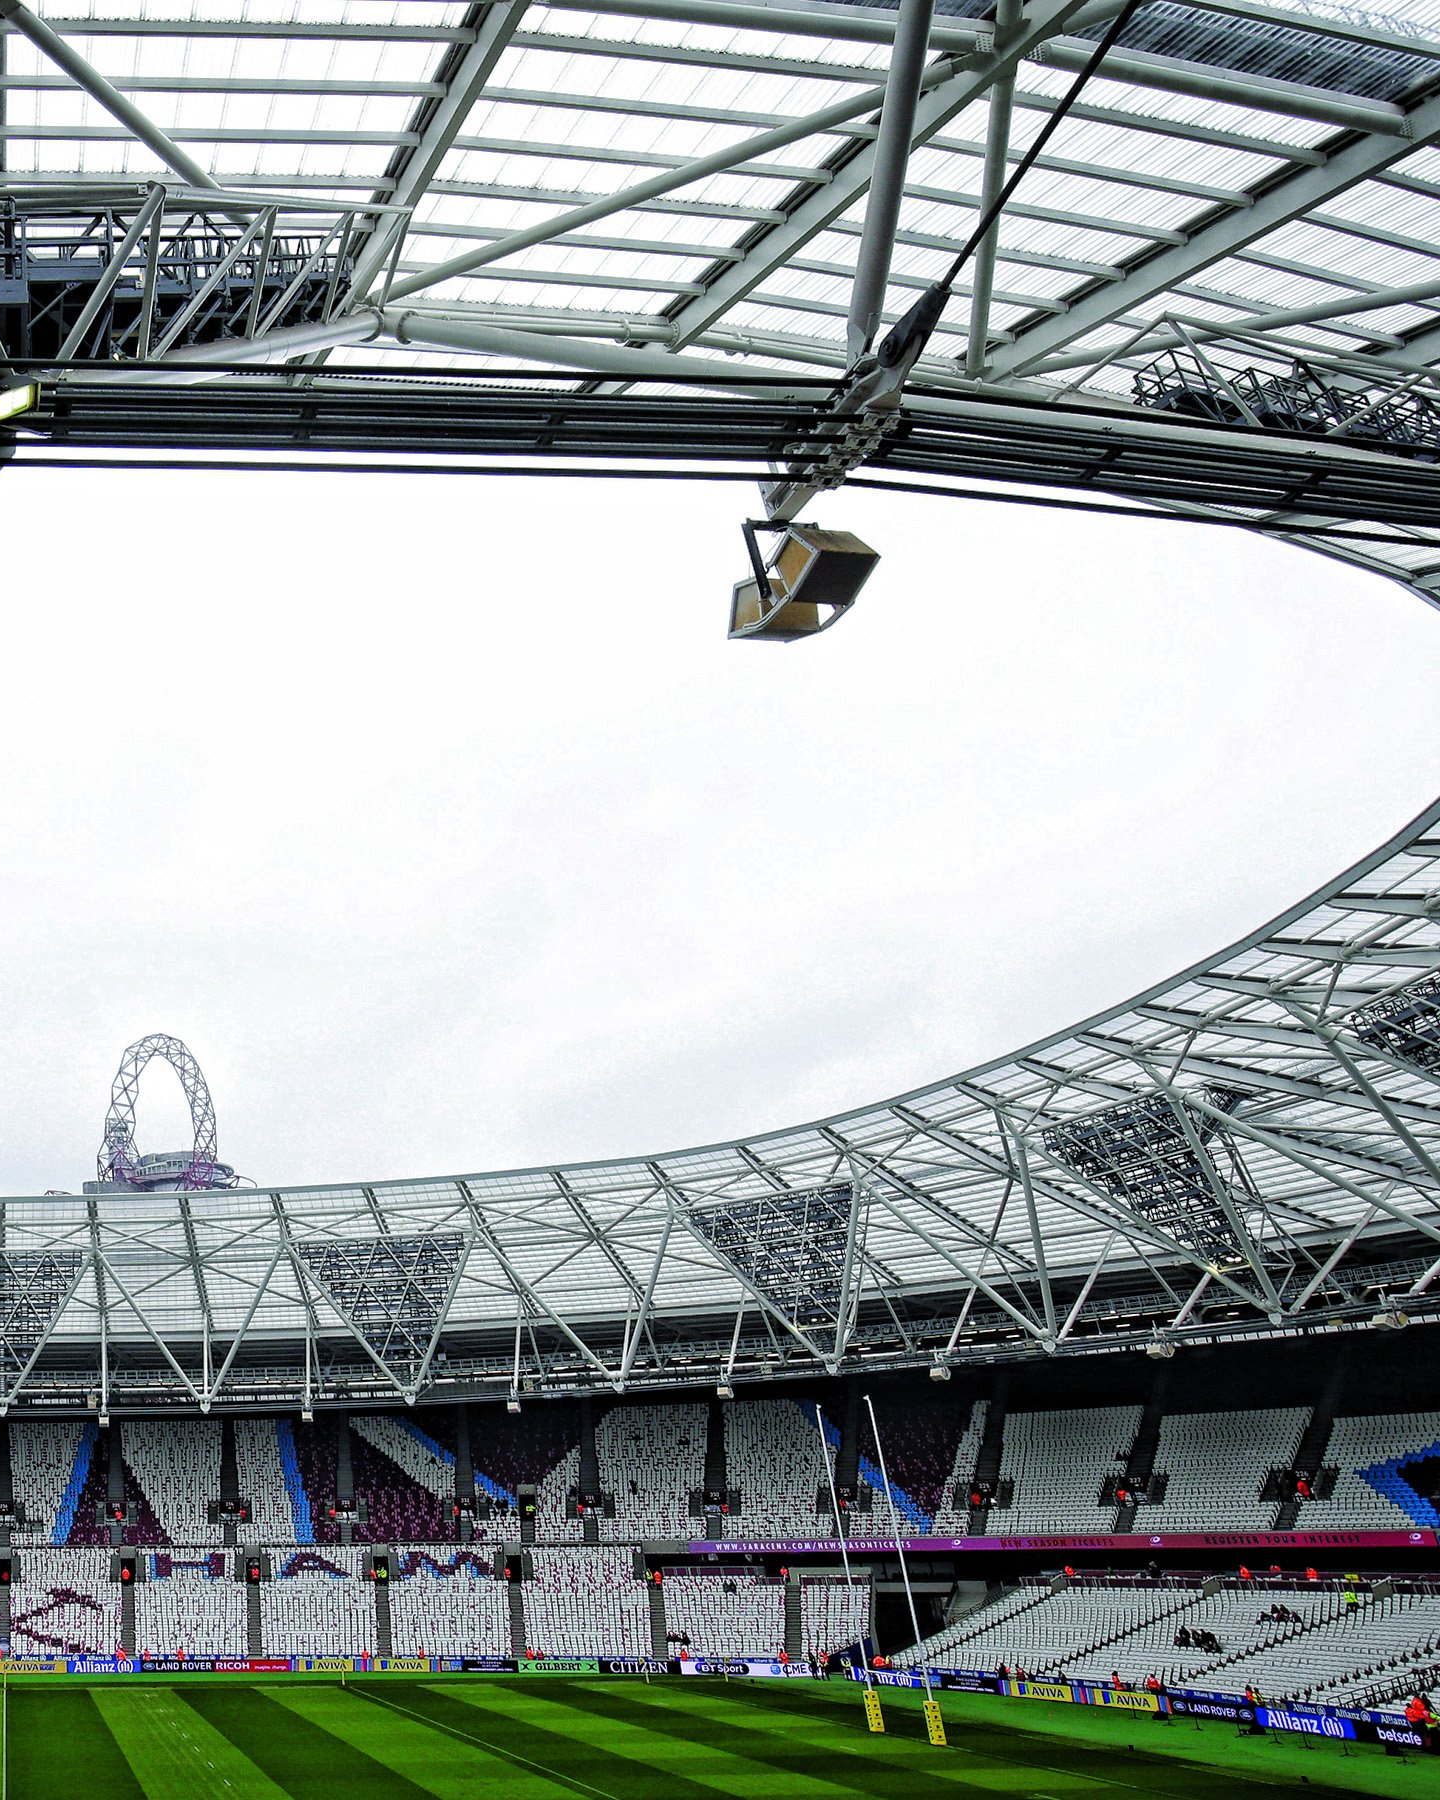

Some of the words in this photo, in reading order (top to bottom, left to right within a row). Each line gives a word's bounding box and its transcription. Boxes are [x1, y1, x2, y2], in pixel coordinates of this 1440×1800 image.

[1000, 1537, 1023, 1549] NEW
[1027, 1537, 1068, 1548] SEASON
[1071, 1536, 1115, 1547] TICKETS
[1203, 1534, 1260, 1546] REGISTER
[1265, 1534, 1298, 1545] YOUR
[1303, 1533, 1361, 1545] INTEREST
[10, 1663, 41, 1672] AVIVA
[74, 1661, 116, 1673] Allianz
[156, 1662, 179, 1671] LAND
[181, 1662, 212, 1671] ROVER
[215, 1662, 250, 1671] RICOH
[317, 1661, 347, 1670] AVIVA
[393, 1661, 423, 1670] AVIVA
[535, 1662, 582, 1672] GILBERT
[609, 1661, 669, 1674] CITIZEN
[702, 1664, 717, 1673] BT
[718, 1663, 744, 1674] Sport
[783, 1664, 807, 1674] CME
[1032, 1687, 1065, 1699] AVIVA
[1116, 1695, 1151, 1708] AVIVA
[1188, 1703, 1211, 1714] LAND
[1211, 1706, 1238, 1718] ROVER
[1293, 1703, 1317, 1715] Allianz
[1335, 1708, 1360, 1720] Allianz
[1266, 1710, 1321, 1733] Allianz
[1380, 1714, 1408, 1727] Allianz
[1376, 1726, 1423, 1746] betsafe
